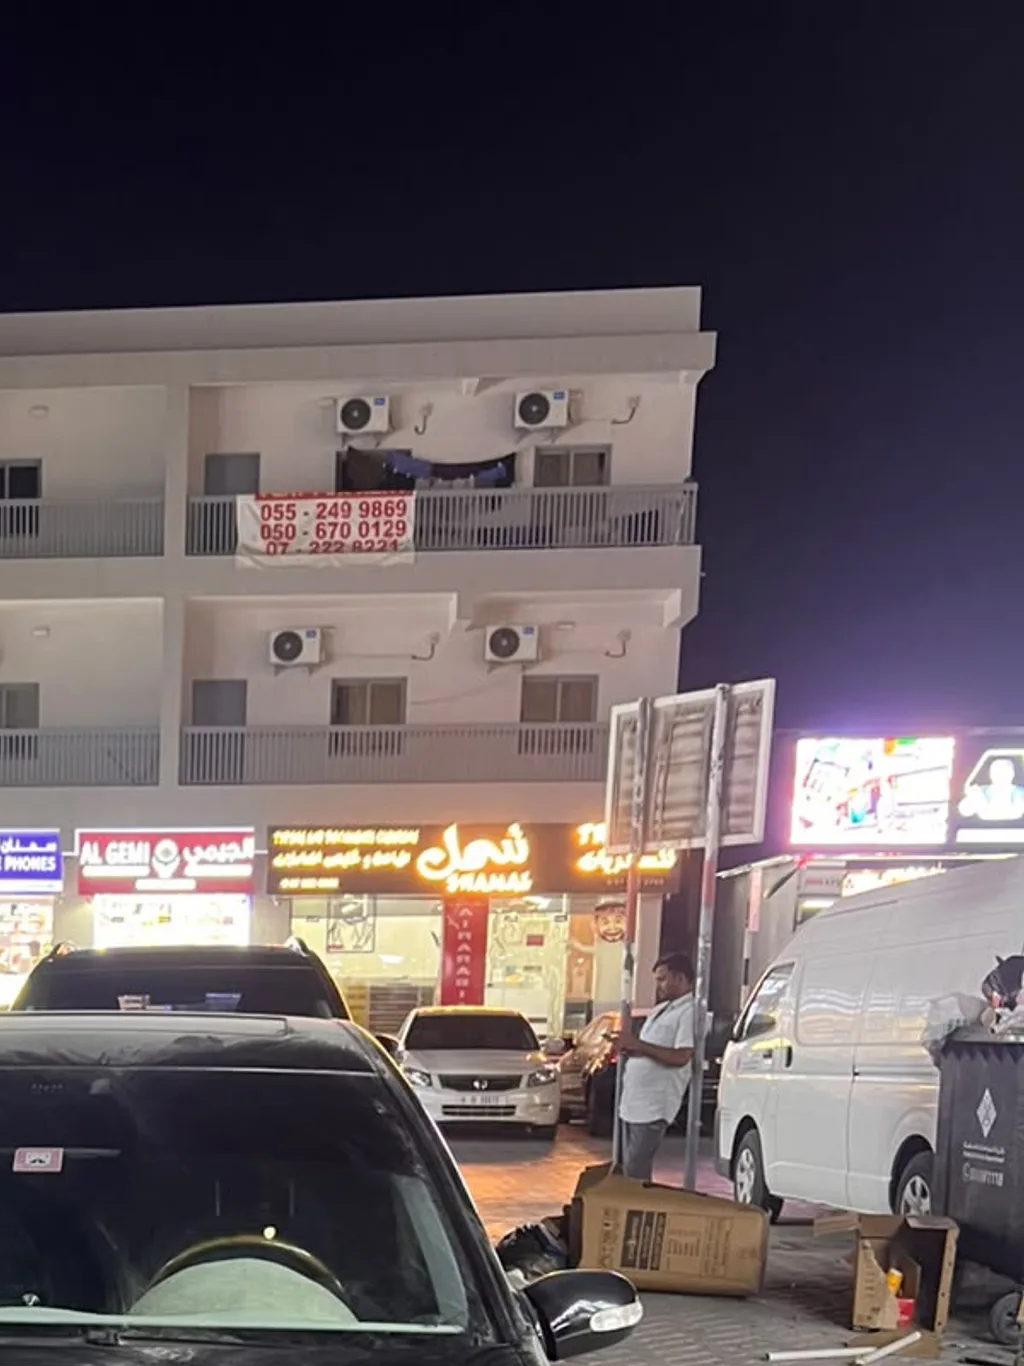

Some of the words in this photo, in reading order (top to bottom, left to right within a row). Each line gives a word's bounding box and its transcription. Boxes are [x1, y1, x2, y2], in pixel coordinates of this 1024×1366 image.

[261, 503, 296, 521] 055
[316, 502, 352, 519] 249
[358, 500, 407, 518] 9869
[261, 523, 296, 541] 050
[316, 521, 351, 540] 670
[358, 520, 407, 538] 0129
[4, 855, 57, 872] PHONES
[80, 840, 103, 866] AL
